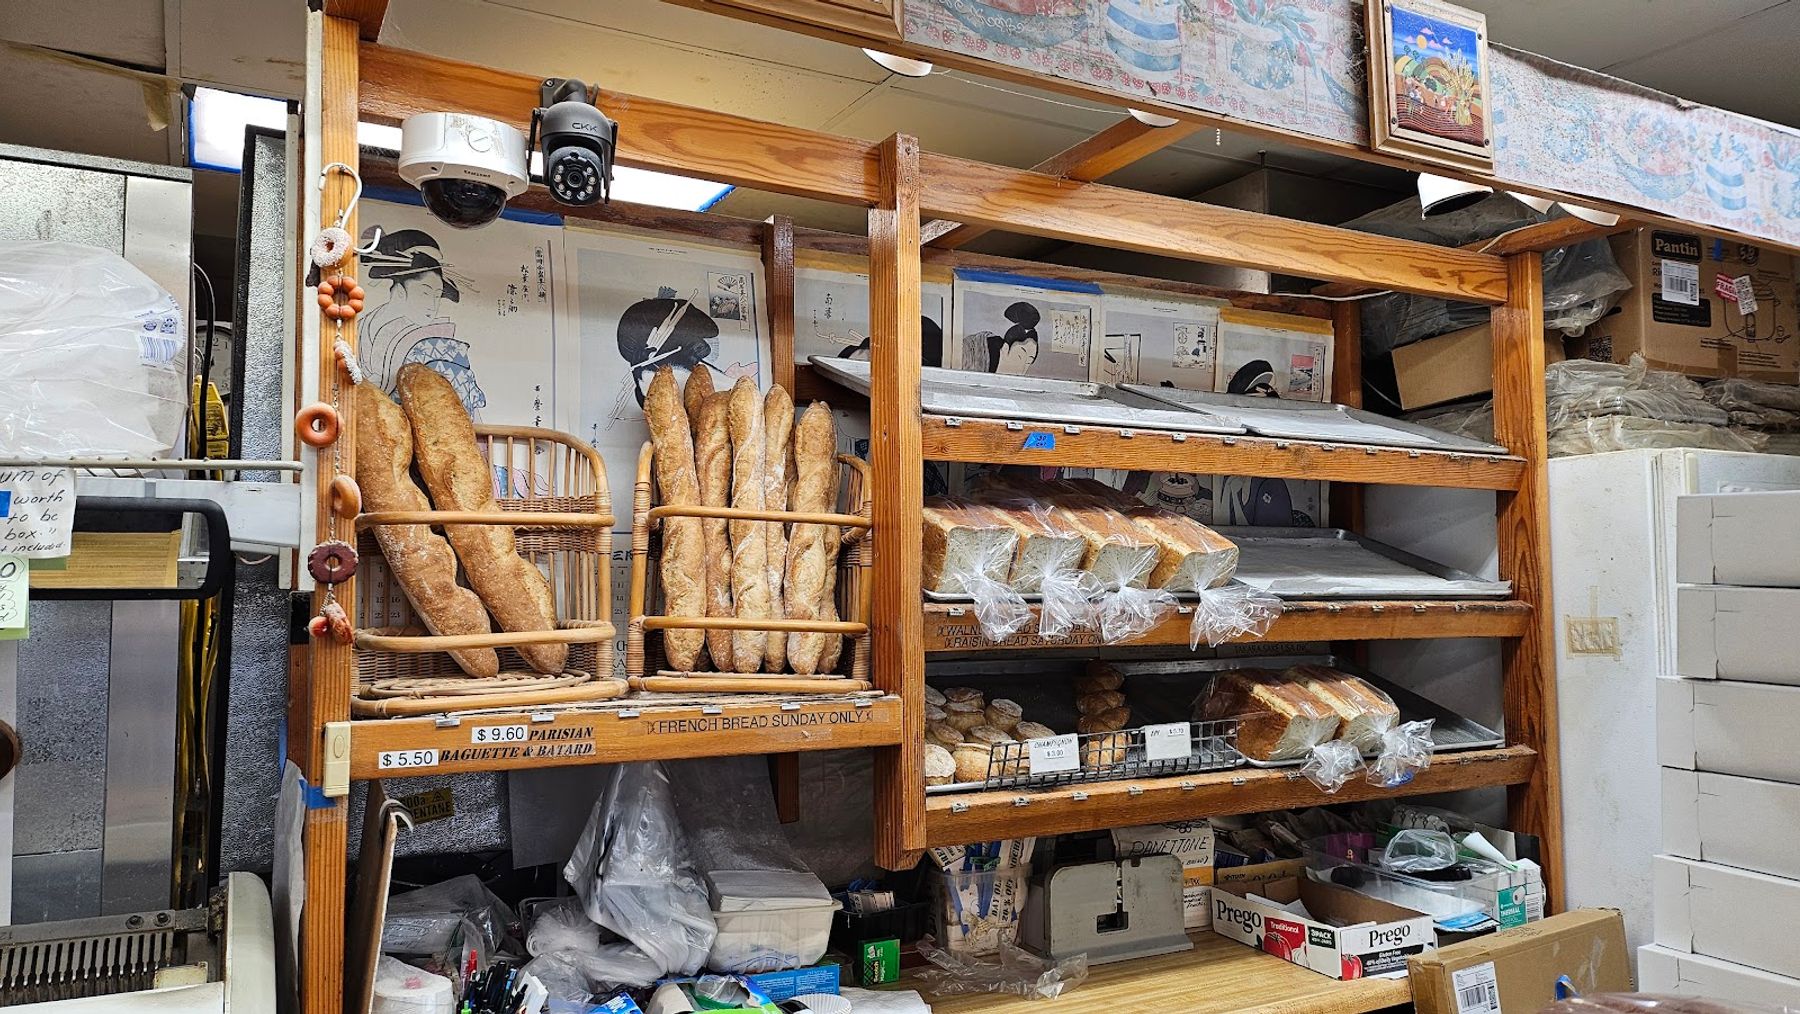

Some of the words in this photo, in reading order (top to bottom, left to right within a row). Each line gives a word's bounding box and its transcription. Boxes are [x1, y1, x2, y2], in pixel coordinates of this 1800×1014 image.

[1655, 238, 1699, 256] Pantin
[41, 469, 67, 487] of
[13, 489, 65, 505] worth
[7, 513, 29, 524] to
[40, 507, 59, 522] be
[659, 717, 718, 734] FRENCH
[722, 714, 768, 730] BREAD
[771, 712, 825, 728] SUNDAY
[829, 710, 863, 725] ONLY
[528, 726, 594, 742] PARISIAN
[440, 746, 520, 762] BAGUETTE
[536, 742, 593, 758] BATARD
[1215, 899, 1262, 934] Prego
[1270, 920, 1299, 933] Traditional
[1369, 924, 1411, 949] Prego
